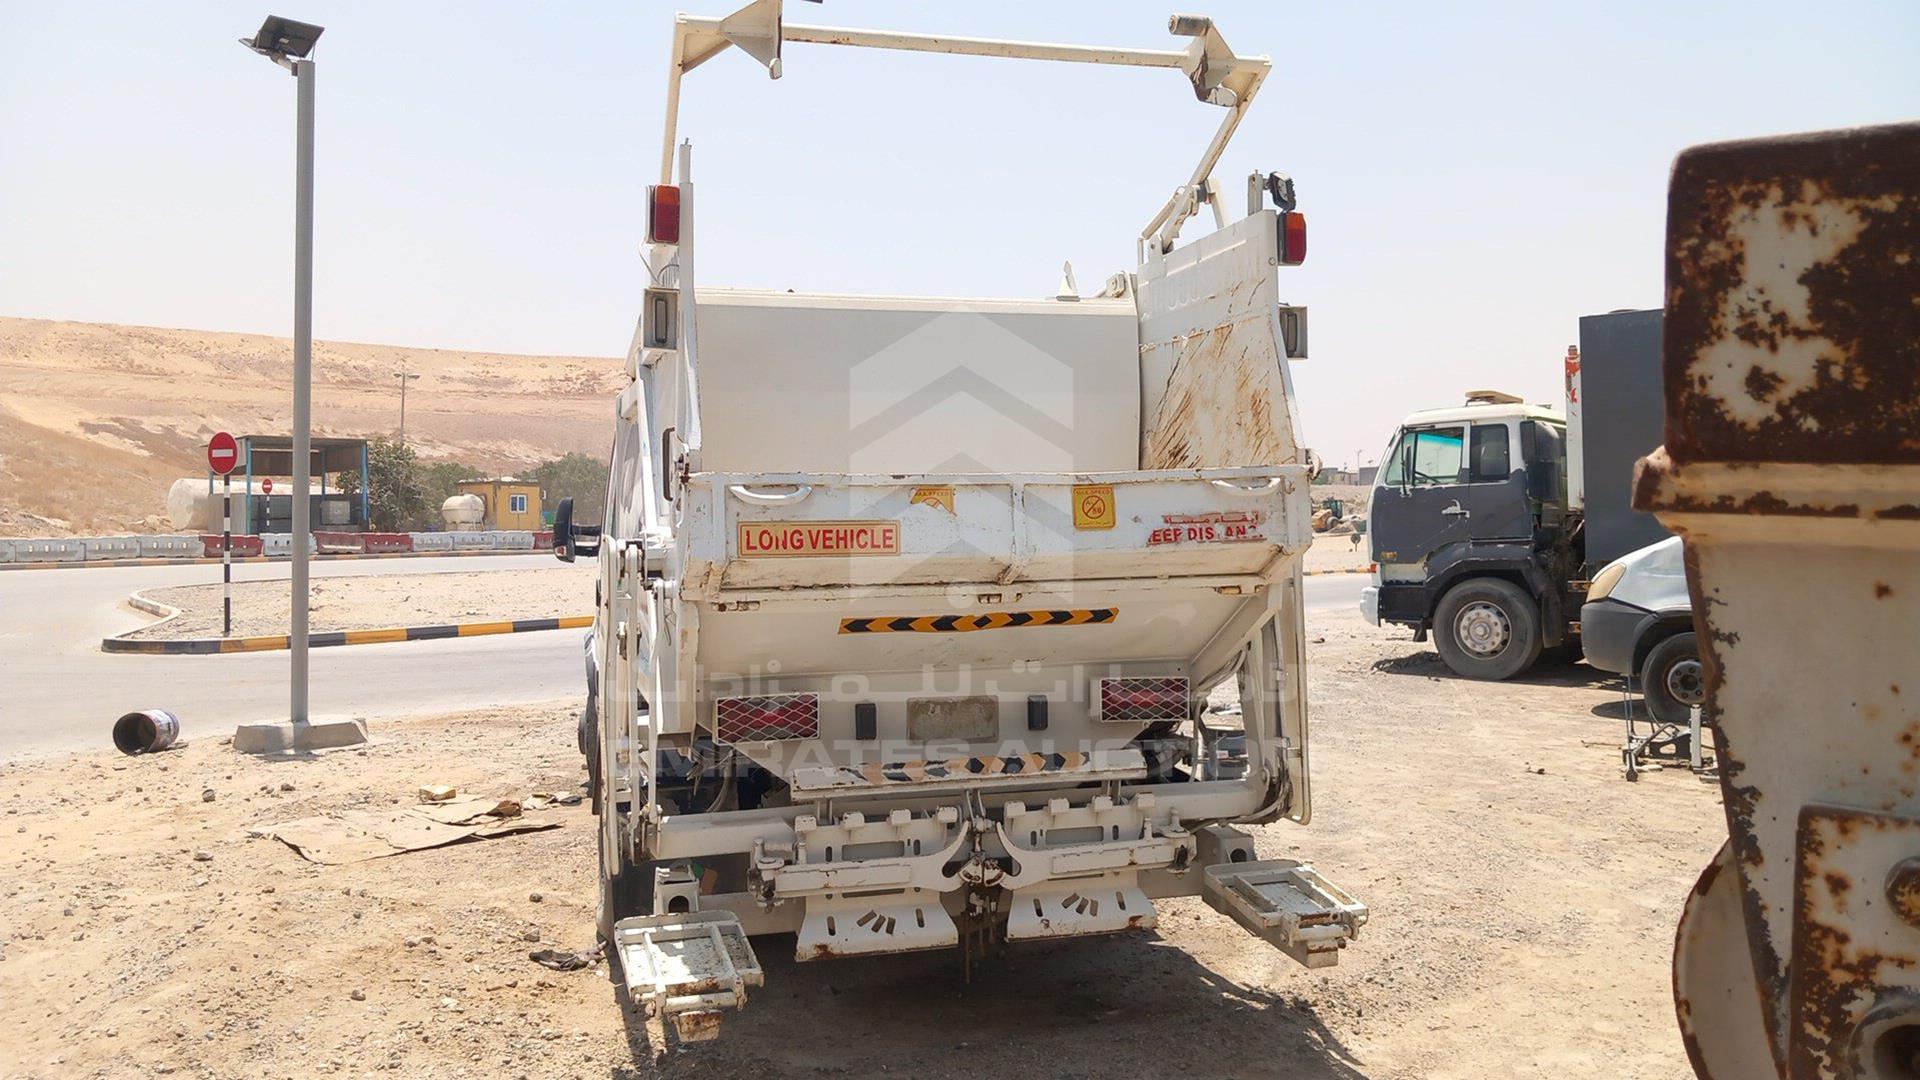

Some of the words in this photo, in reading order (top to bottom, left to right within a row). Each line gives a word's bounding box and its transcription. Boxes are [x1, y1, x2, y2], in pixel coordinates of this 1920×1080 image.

[746, 529, 804, 550] LONG
[808, 528, 894, 549] VEHICLE
[1148, 528, 1182, 543] EEP
